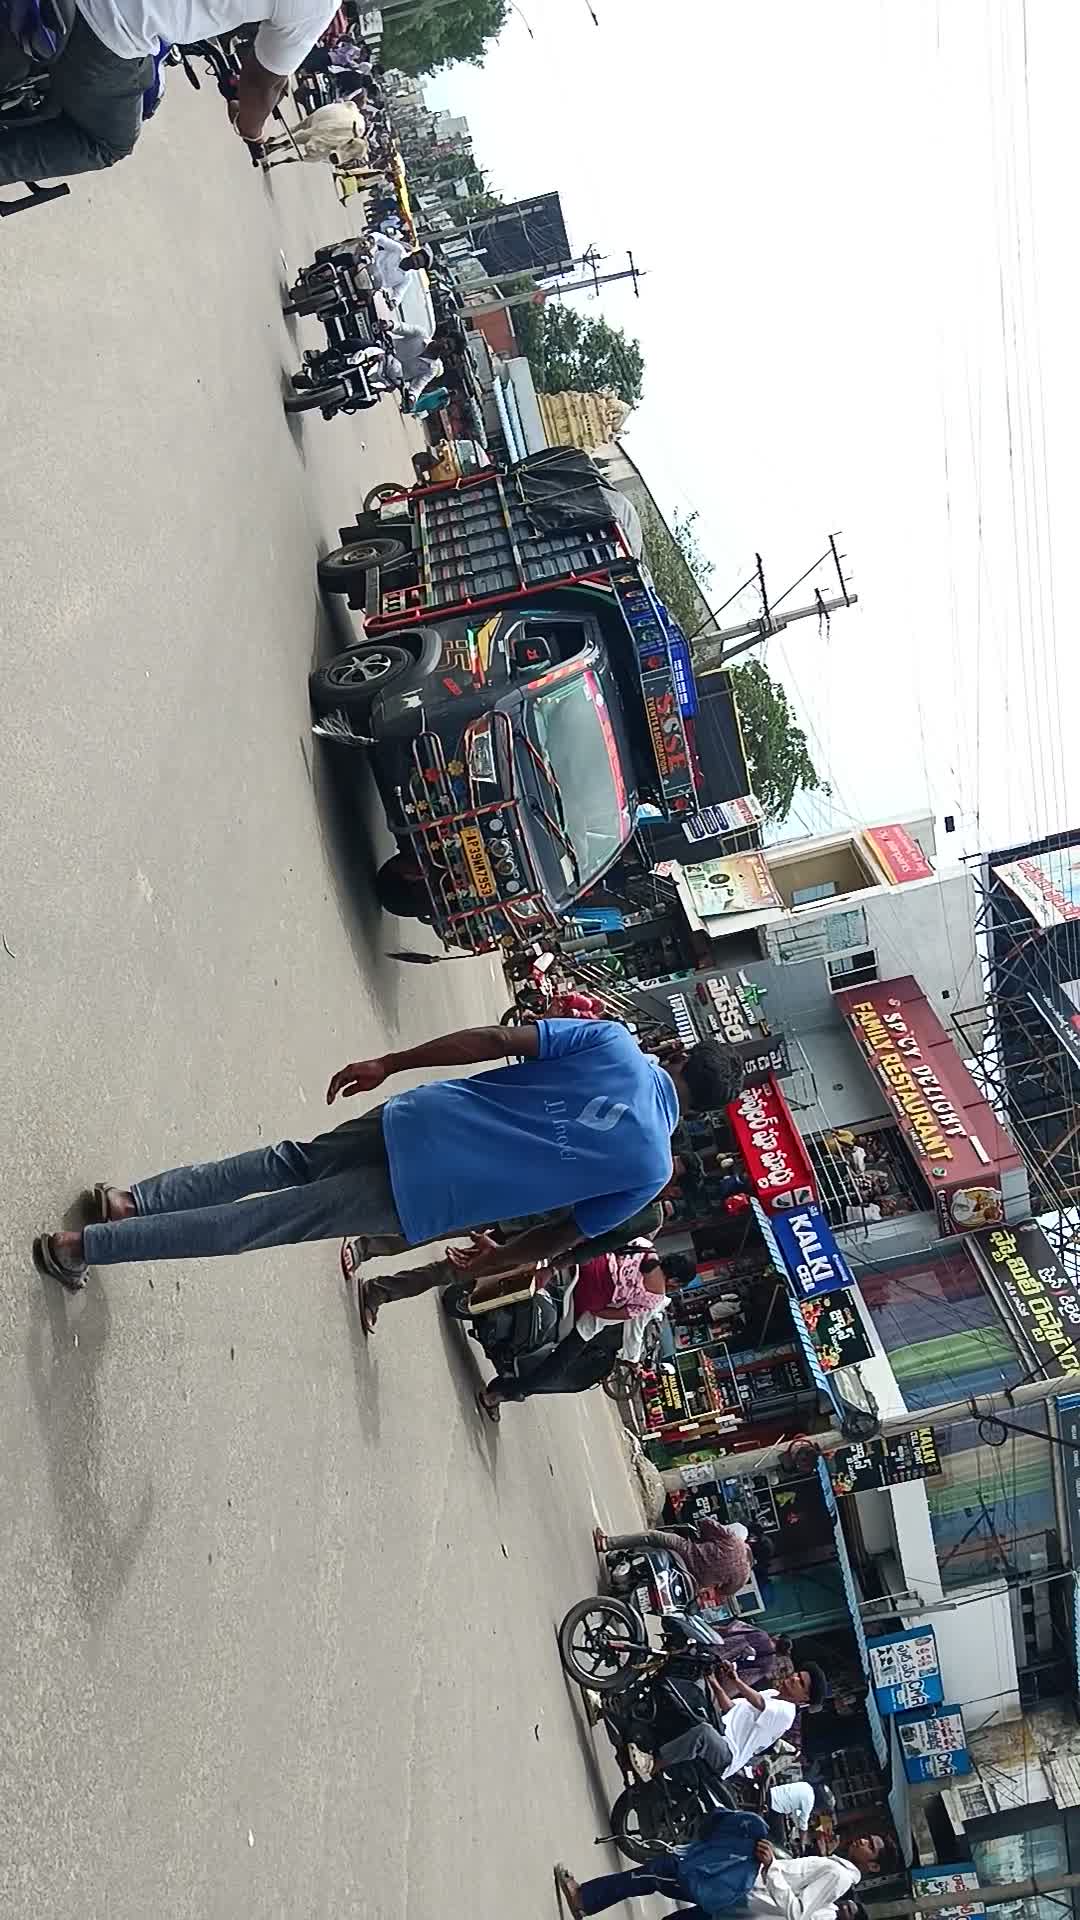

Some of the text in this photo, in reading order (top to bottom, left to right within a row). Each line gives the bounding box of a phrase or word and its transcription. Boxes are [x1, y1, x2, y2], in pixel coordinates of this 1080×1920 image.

[646, 697, 659, 726] EVENTS
[653, 732, 669, 776] DECORATIONS
[656, 693, 687, 772] SSSE
[465, 834, 493, 896] AP39WM7953
[853, 1001, 953, 1161] FAMILY RESTAURANT
[883, 1012, 967, 1138] SPICY DELIGHT
[788, 1213, 835, 1282] KALKI
[796, 1264, 816, 1293] CELL
[918, 1427, 936, 1464] KALKI
[908, 1679, 930, 1707] CMR
[937, 1753, 956, 1776] CMR
